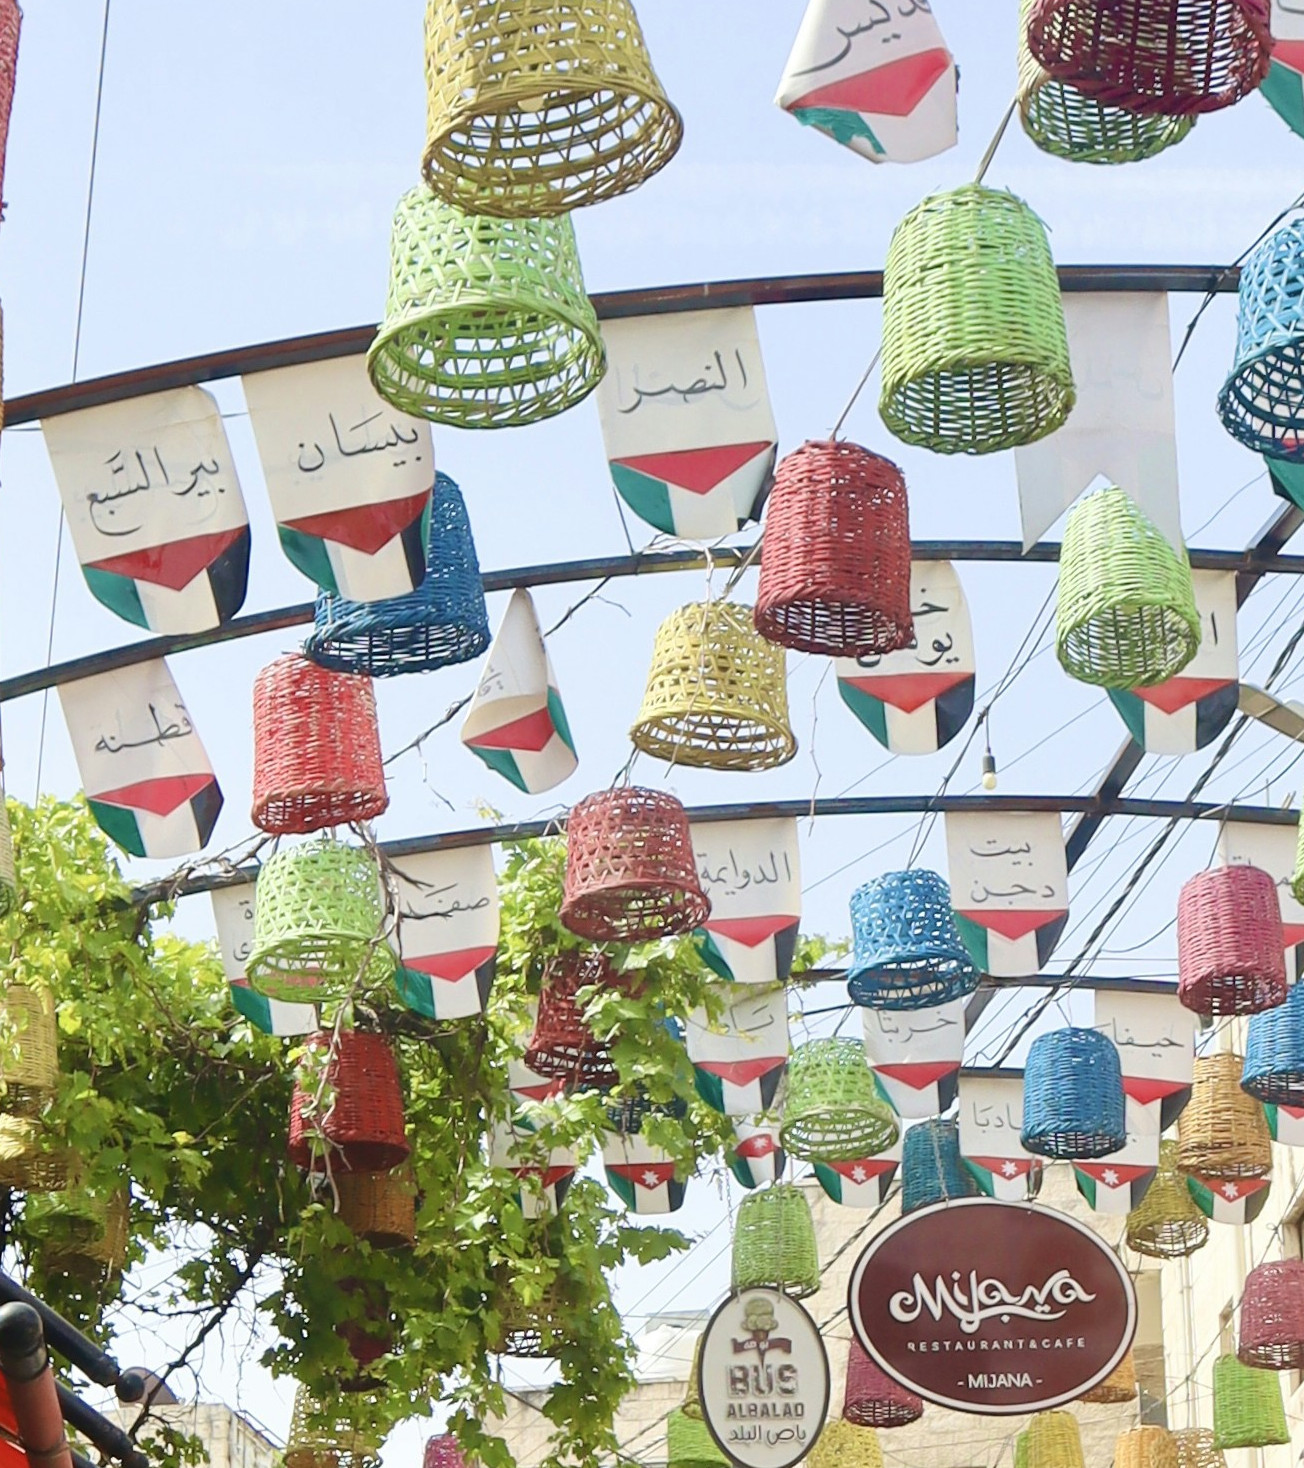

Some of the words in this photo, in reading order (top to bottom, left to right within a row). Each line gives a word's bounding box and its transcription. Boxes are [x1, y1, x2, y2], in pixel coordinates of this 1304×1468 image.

[617, 347, 748, 414] النصر
[171, 458, 226, 497] بير
[969, 837, 1035, 867] بيت
[696, 847, 792, 896] الدوايمة
[970, 877, 1056, 903] دجن
[726, 1363, 798, 1397] BUS
[726, 1402, 805, 1419] ALBALAD
